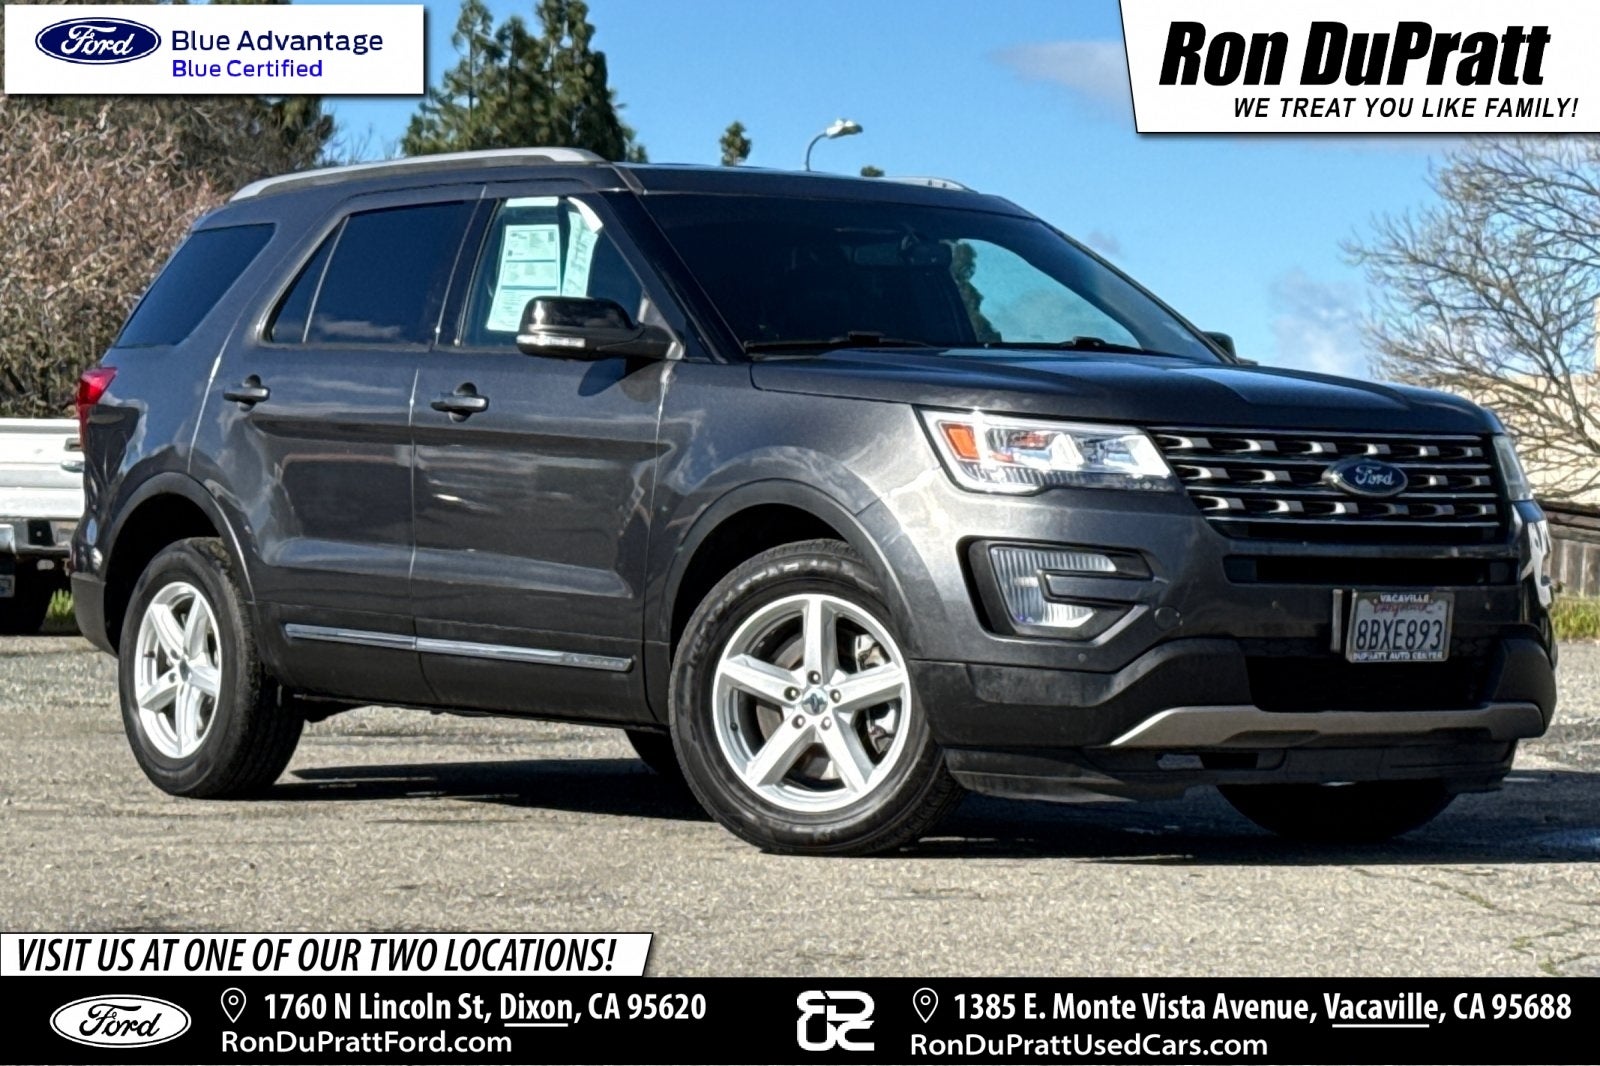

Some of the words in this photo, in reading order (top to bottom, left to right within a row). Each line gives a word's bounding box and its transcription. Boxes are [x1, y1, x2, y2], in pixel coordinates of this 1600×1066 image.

[1355, 465, 1394, 486] Ford
[1380, 593, 1430, 603] VACAVILLE
[1355, 618, 1443, 651] 8BXE893
[1389, 651, 1411, 660] AUTO
